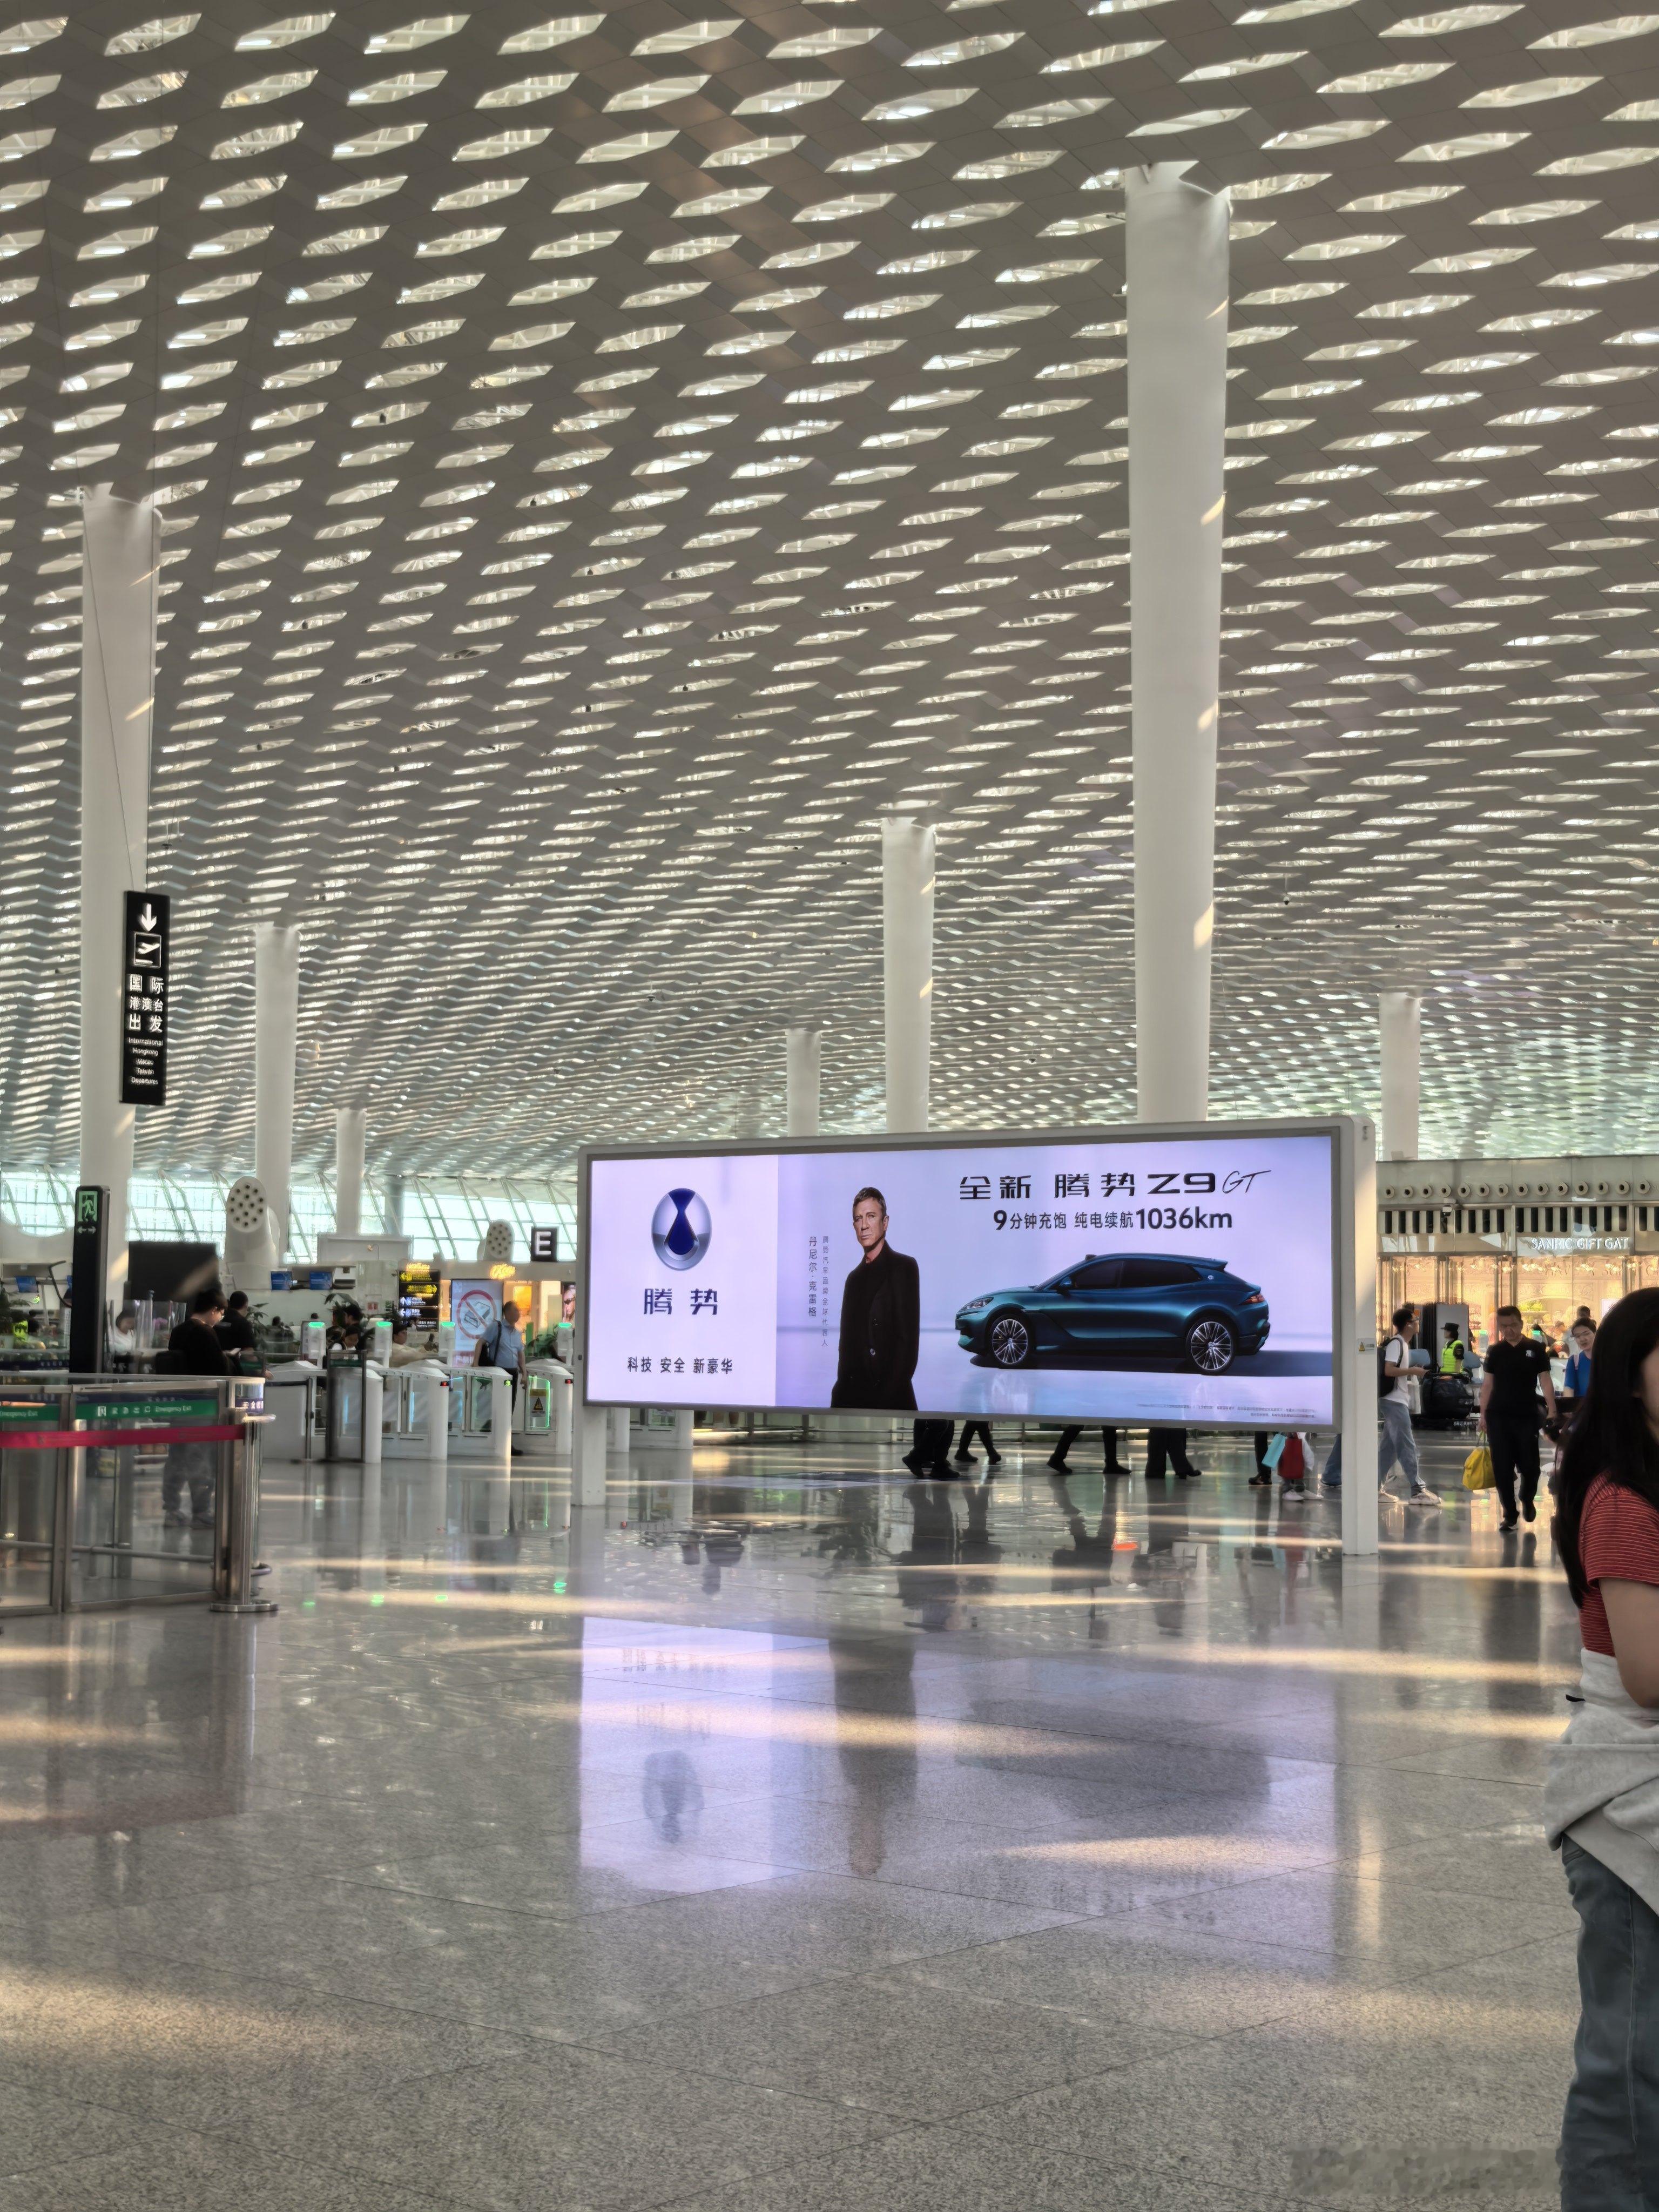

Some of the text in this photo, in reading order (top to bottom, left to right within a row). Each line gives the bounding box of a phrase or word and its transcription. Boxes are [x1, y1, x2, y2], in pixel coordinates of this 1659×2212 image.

[129, 974, 164, 994] 国际
[129, 1013, 163, 1033] 出发
[129, 1037, 163, 1047] International
[960, 1175, 1031, 1199] 全新
[535, 1231, 551, 1256] E
[1576, 1237, 1602, 1250] GIFT
[644, 1288, 718, 1316] 腾势
[627, 1356, 733, 1374] 科技 安全 新豪华
